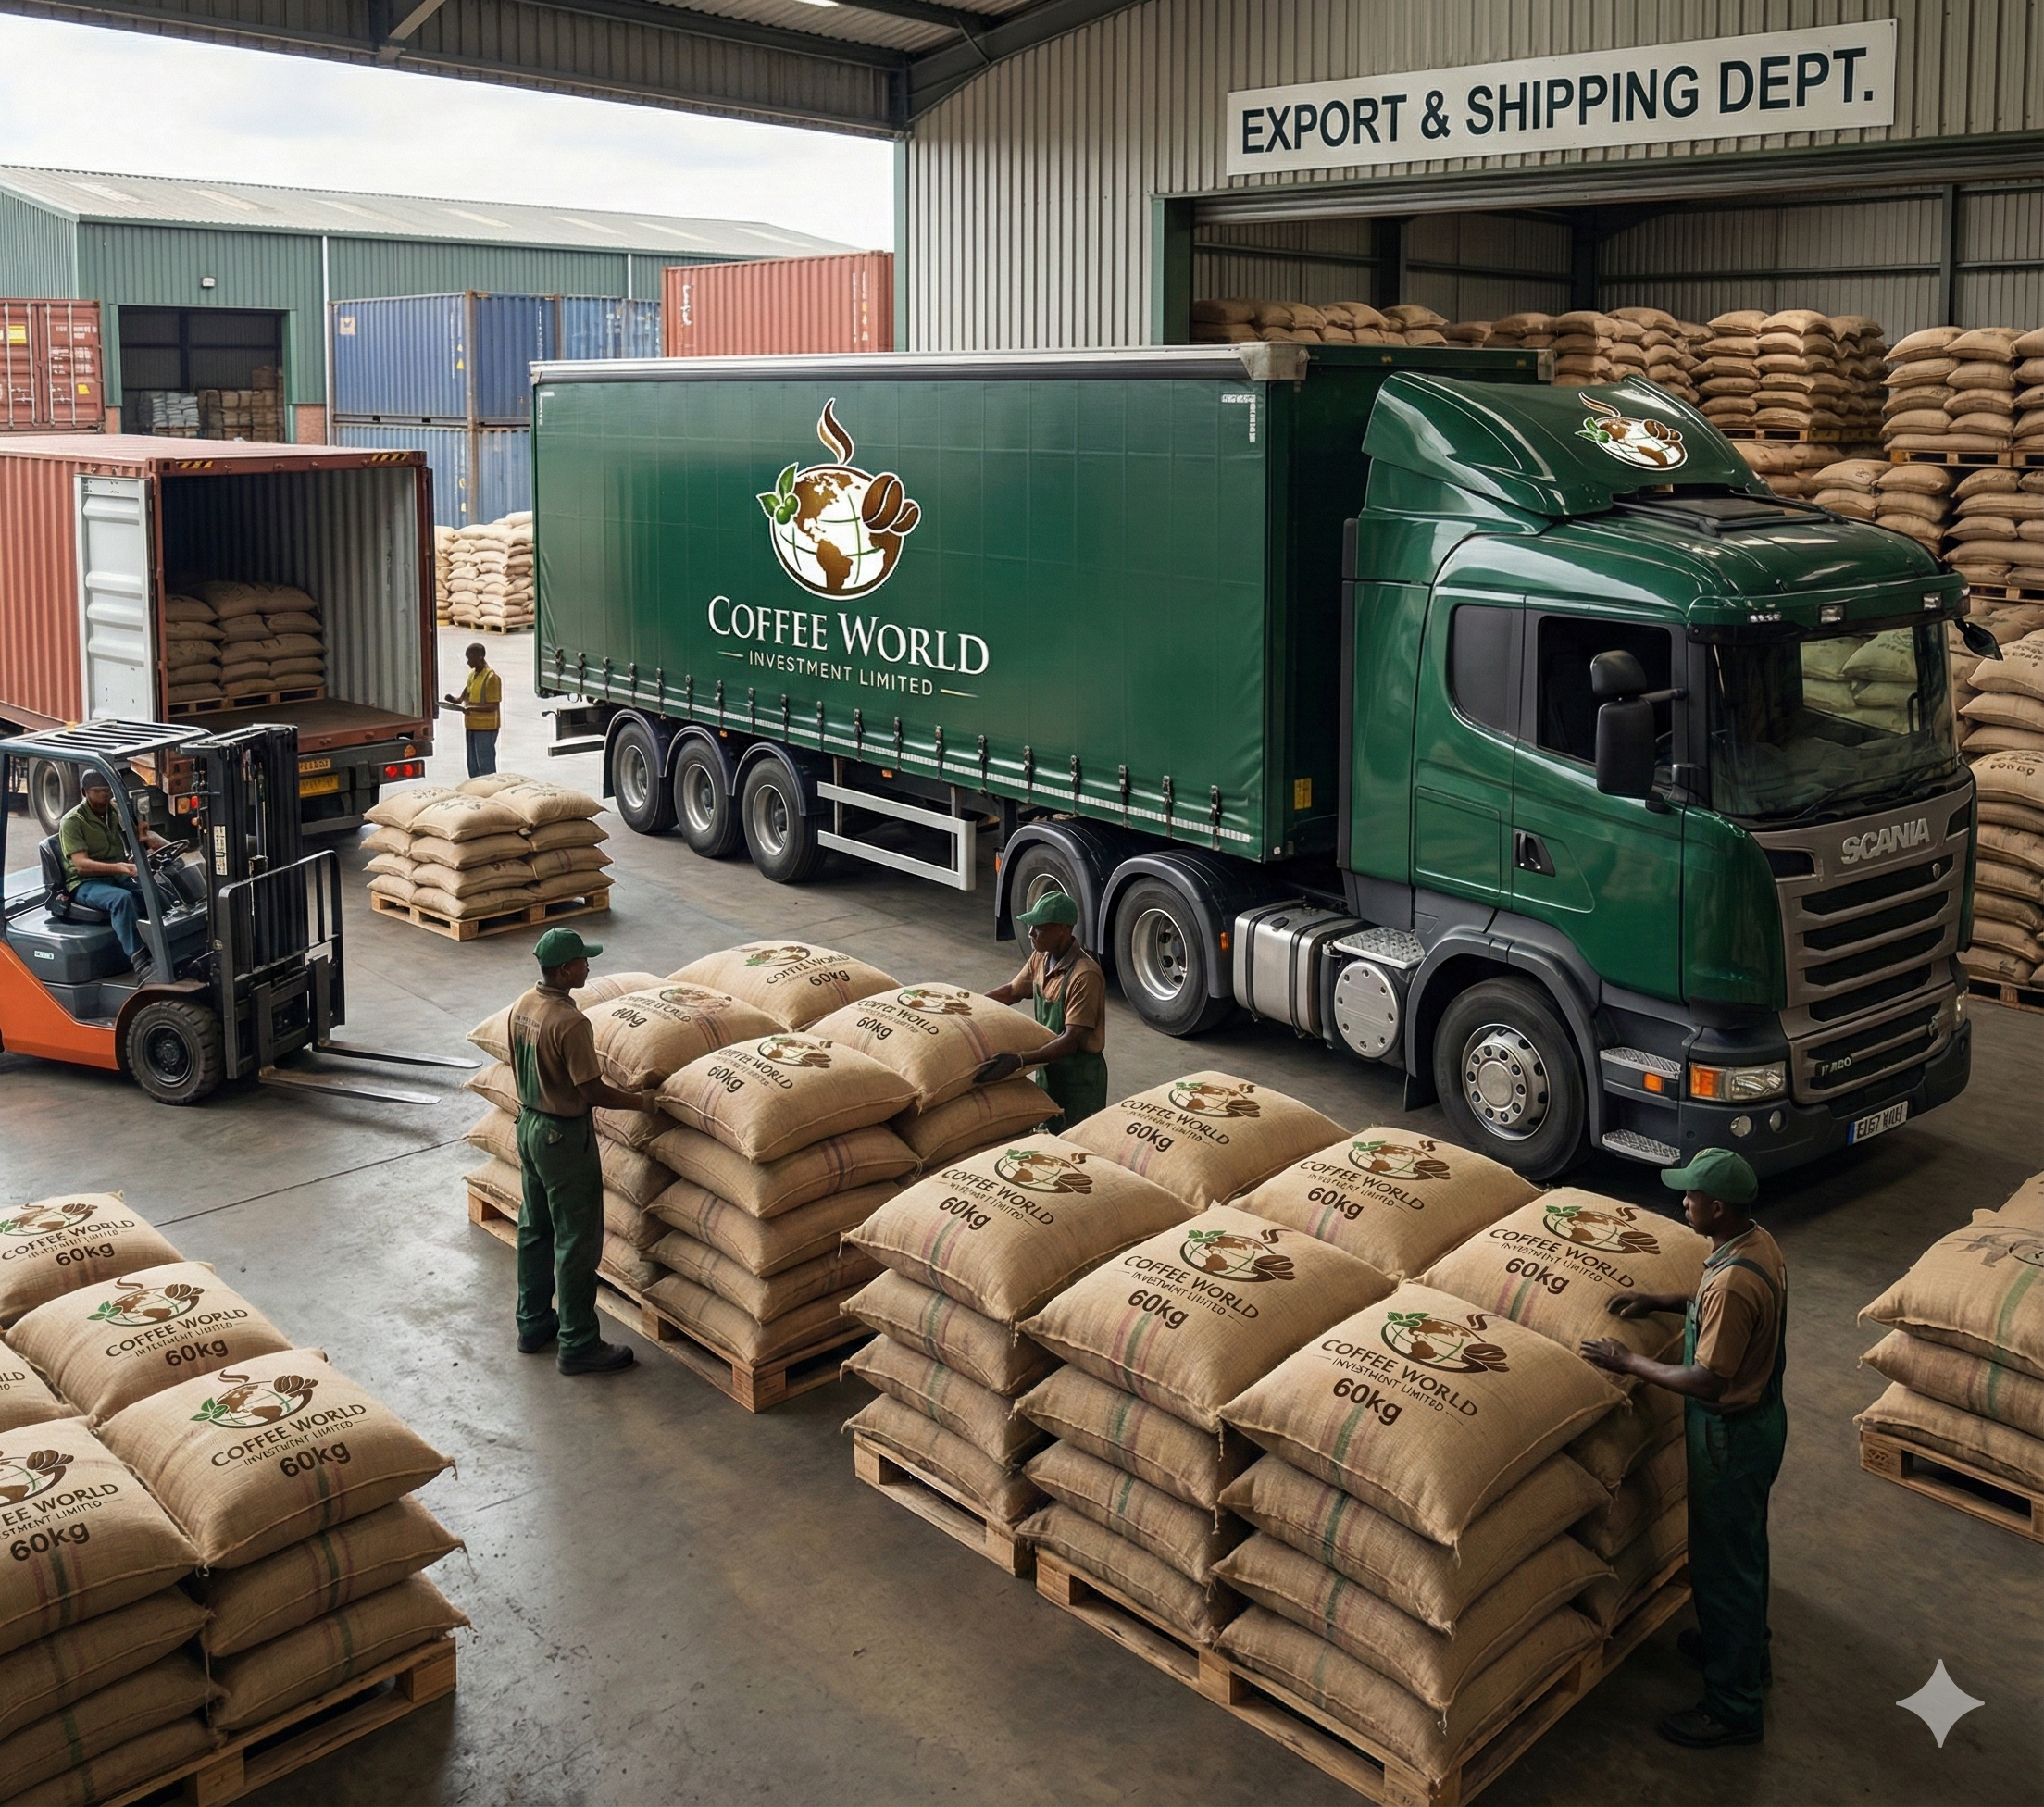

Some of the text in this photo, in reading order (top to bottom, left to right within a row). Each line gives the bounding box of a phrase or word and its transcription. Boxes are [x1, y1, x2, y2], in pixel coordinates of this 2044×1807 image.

[1241, 46, 1875, 155] EXPORT & SHIPPING DEPT.
[707, 595, 990, 675] COFFEE WORLD
[749, 650, 933, 695] INVESTMENT LIMITED
[1840, 817, 1931, 865] SCANIA
[809, 969, 851, 986] 60kg
[856, 1016, 894, 1041] 60kg
[896, 1009, 940, 1035] WORLD
[707, 1065, 745, 1093] 60kg
[752, 1059, 793, 1090] WORLD
[1126, 1122, 1175, 1153] 60kg
[1177, 1113, 1230, 1145] WORLD
[941, 1168, 999, 1192] COFFEE
[997, 1186, 1054, 1225] WORLD
[1300, 1161, 1425, 1210] COFFEE WORLD
[1307, 1187, 1365, 1221] 60kg
[68, 1220, 136, 1237] WORLD
[939, 1196, 991, 1230] 60kg
[56, 1242, 116, 1266] 60kg
[1489, 1228, 1635, 1288] COFFEE WORLD
[1124, 1255, 1259, 1319] COFFEE WORLD
[1505, 1257, 1570, 1295] 60kg
[1128, 1290, 1190, 1330] 60kg
[106, 1309, 248, 1357] COFFEE WORLD
[165, 1339, 229, 1366] 60kg
[1321, 1339, 1478, 1416] COFFEE WORLD
[1332, 1377, 1403, 1427] 60kg
[211, 1403, 367, 1467] COFFEE WORLD
[280, 1441, 351, 1477] 60kg
[32, 1483, 118, 1514] WORLD
[10, 1522, 91, 1562] 60kg
